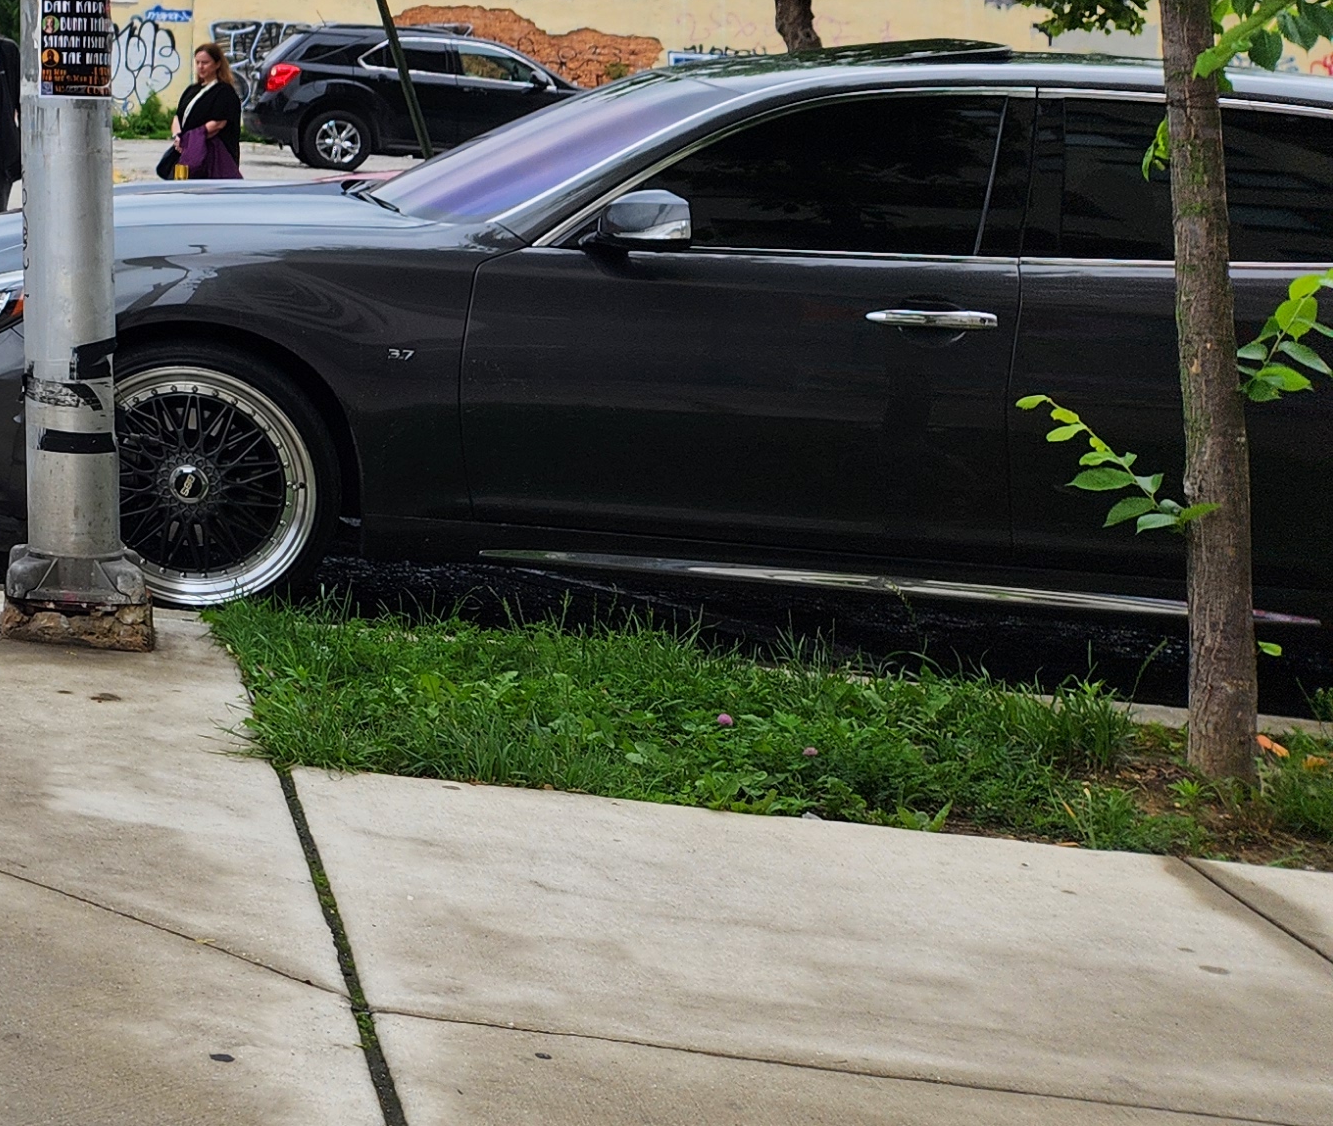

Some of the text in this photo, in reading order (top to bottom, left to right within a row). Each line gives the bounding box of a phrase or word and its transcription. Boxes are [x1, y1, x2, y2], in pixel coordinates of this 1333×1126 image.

[43, 0, 71, 13] DAN
[60, 16, 88, 32] BUNNY
[180, 474, 195, 496] BBS
